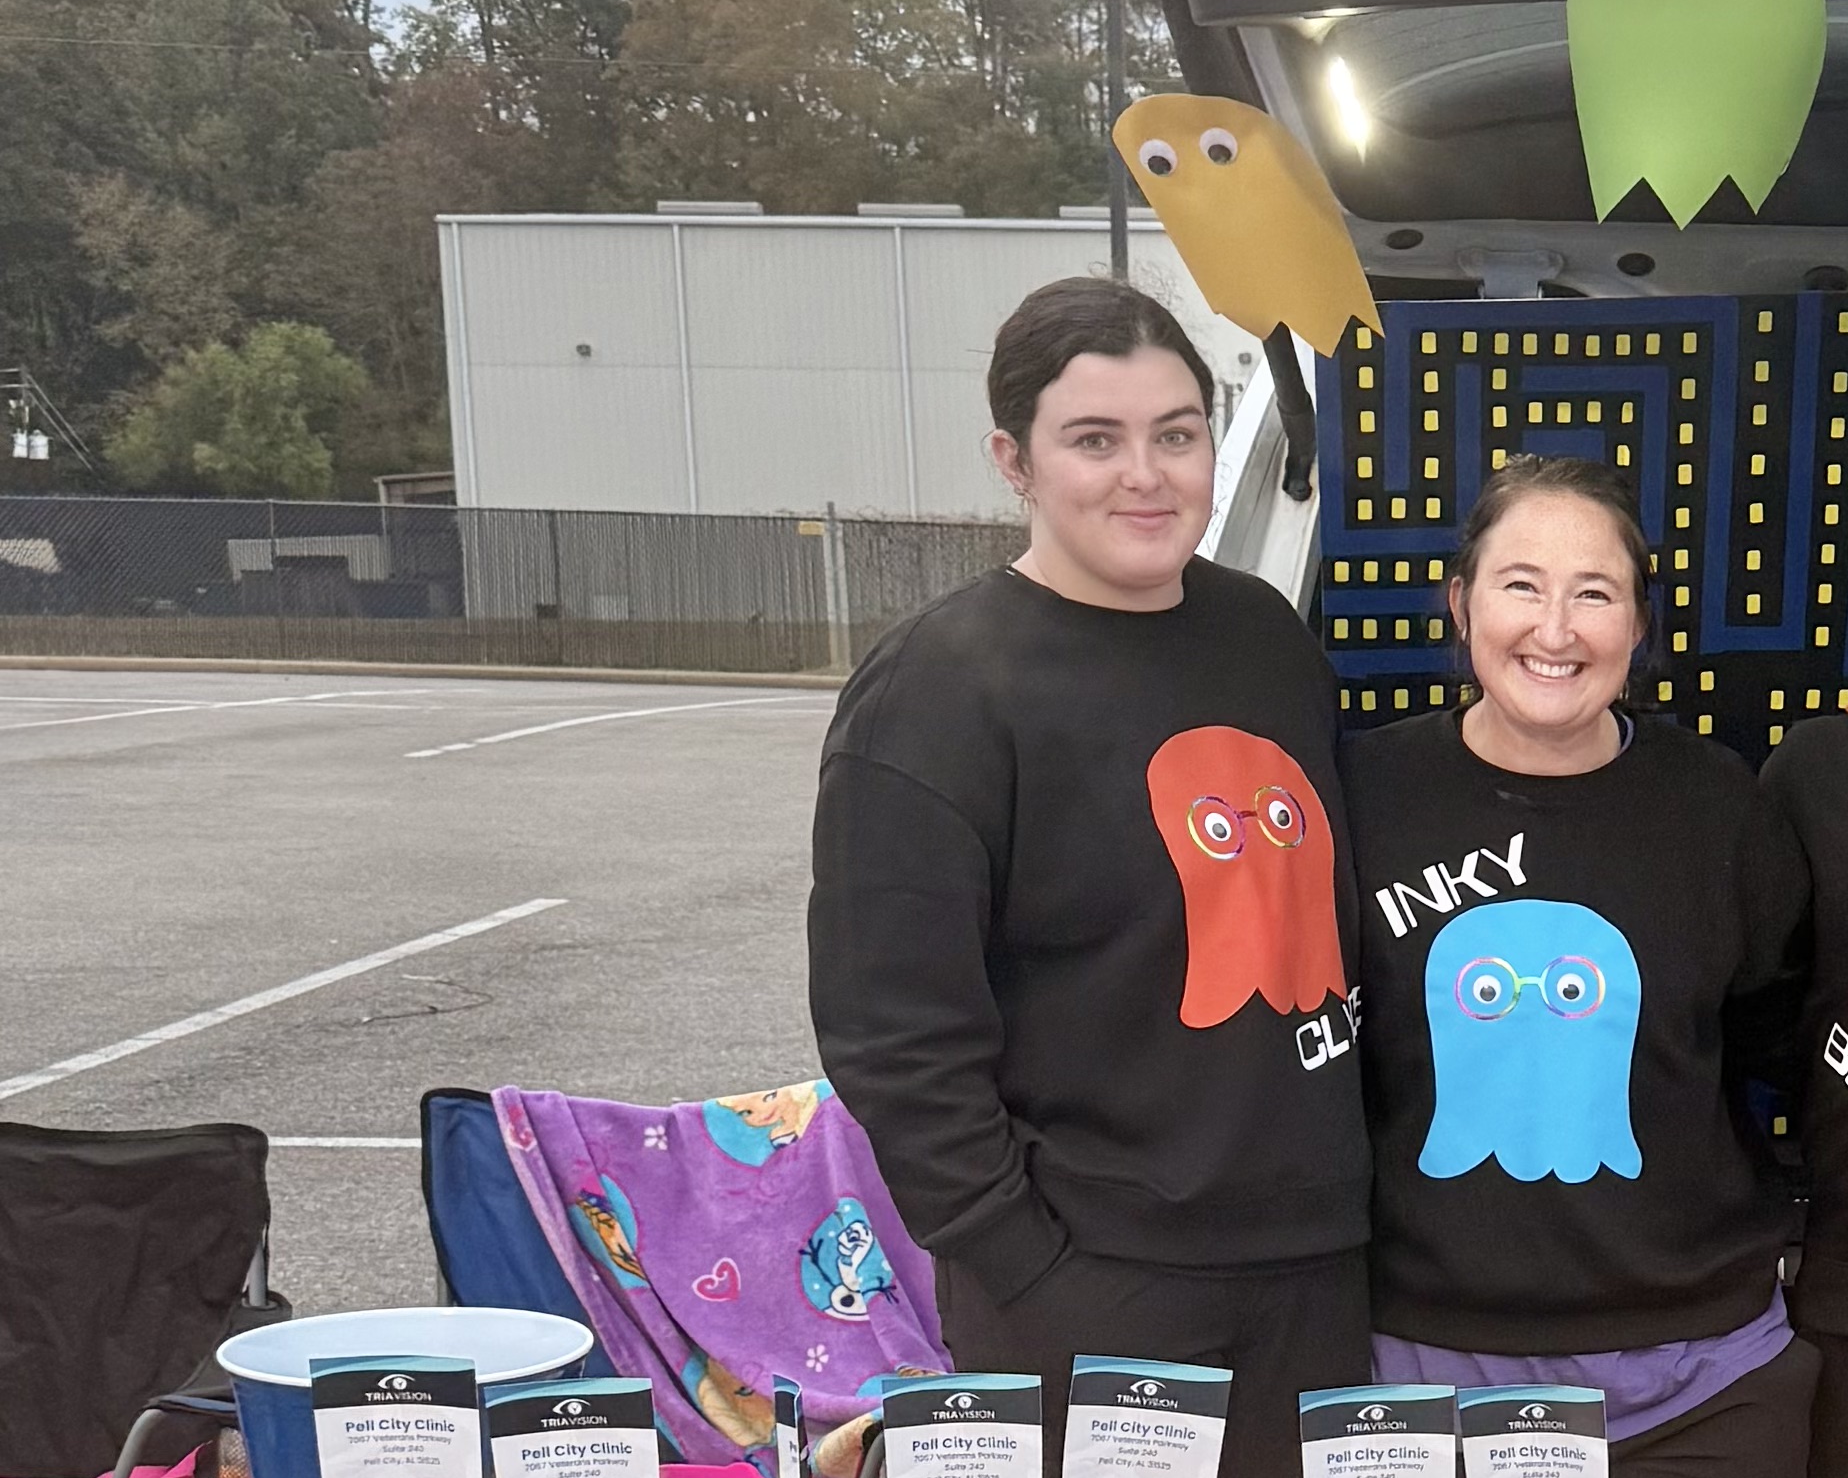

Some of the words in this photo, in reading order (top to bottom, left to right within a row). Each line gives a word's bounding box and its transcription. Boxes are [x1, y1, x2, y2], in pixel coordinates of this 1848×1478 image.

[1375, 832, 1527, 938] INKY
[365, 1392, 431, 1402] TRIAVISION
[1117, 1394, 1178, 1408] TRIAVISION
[541, 1416, 607, 1427] TRIAVISION
[932, 1410, 995, 1420] TRIAVISION
[345, 1421, 374, 1433] Pell
[379, 1418, 410, 1433] City
[415, 1419, 455, 1432] Clinic
[1092, 1420, 1117, 1431] Pell
[1121, 1421, 1150, 1437] City
[1154, 1425, 1196, 1439] Clinic
[1346, 1421, 1407, 1433] TRIAVISION
[522, 1447, 550, 1460] Pell
[555, 1444, 586, 1457] City
[591, 1442, 632, 1454] Clinic
[913, 1438, 938, 1451] Pell
[942, 1436, 972, 1451] City
[977, 1436, 1017, 1449] Clinic
[1327, 1451, 1351, 1464] Pell
[1355, 1448, 1384, 1463] City
[1388, 1446, 1429, 1459] Clinic
